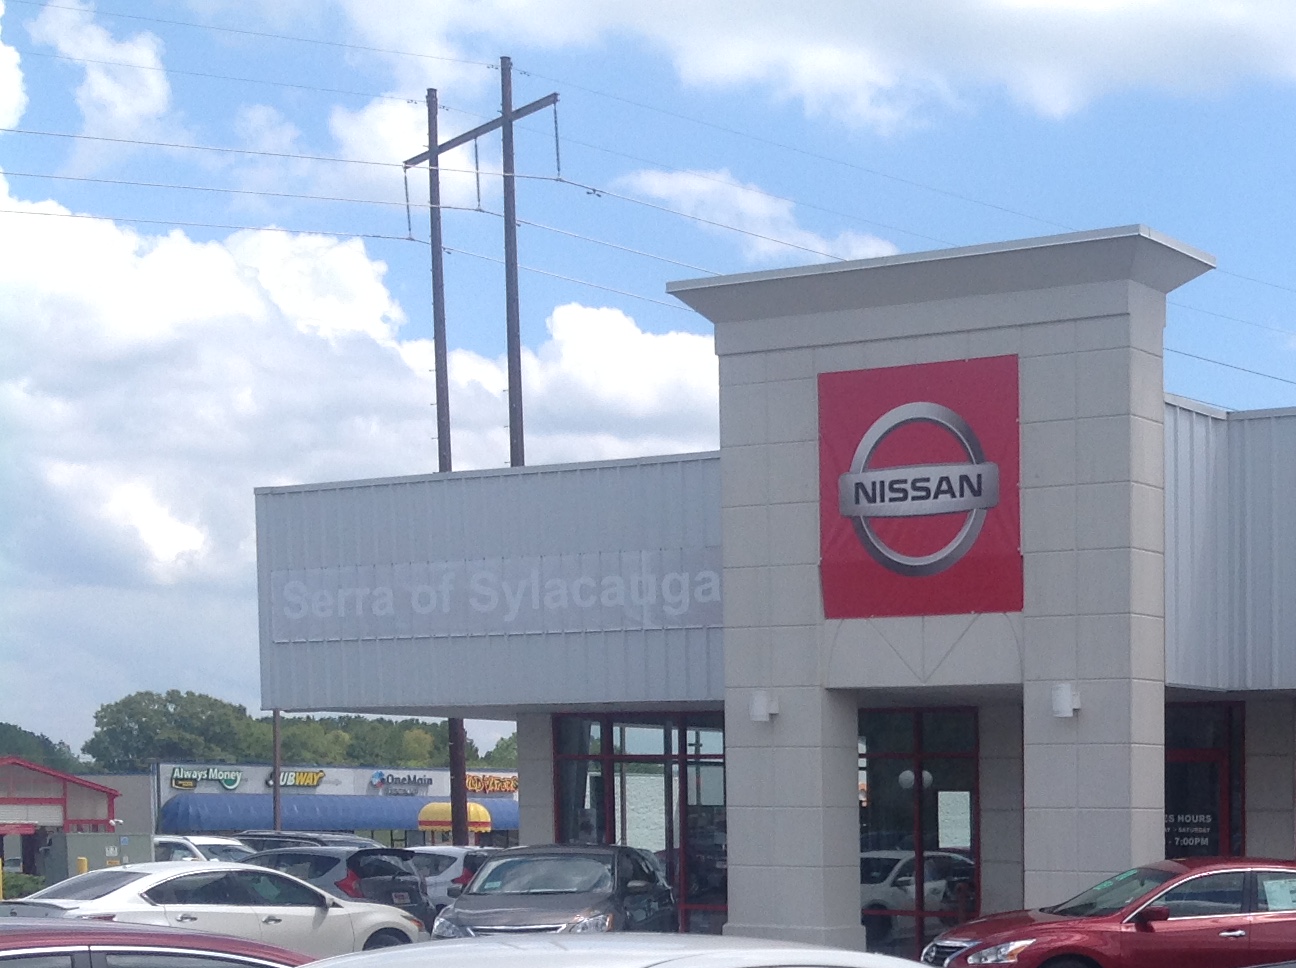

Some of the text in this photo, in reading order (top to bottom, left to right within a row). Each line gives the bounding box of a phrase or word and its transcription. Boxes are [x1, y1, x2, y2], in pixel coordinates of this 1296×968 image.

[854, 474, 982, 504] NISSAN
[283, 568, 722, 624] Serra of Sylacauga
[173, 768, 242, 782] Always Money
[386, 774, 433, 786] OneMain
[1177, 815, 1212, 823] HOURS
[1175, 837, 1209, 846] 7:00PM
